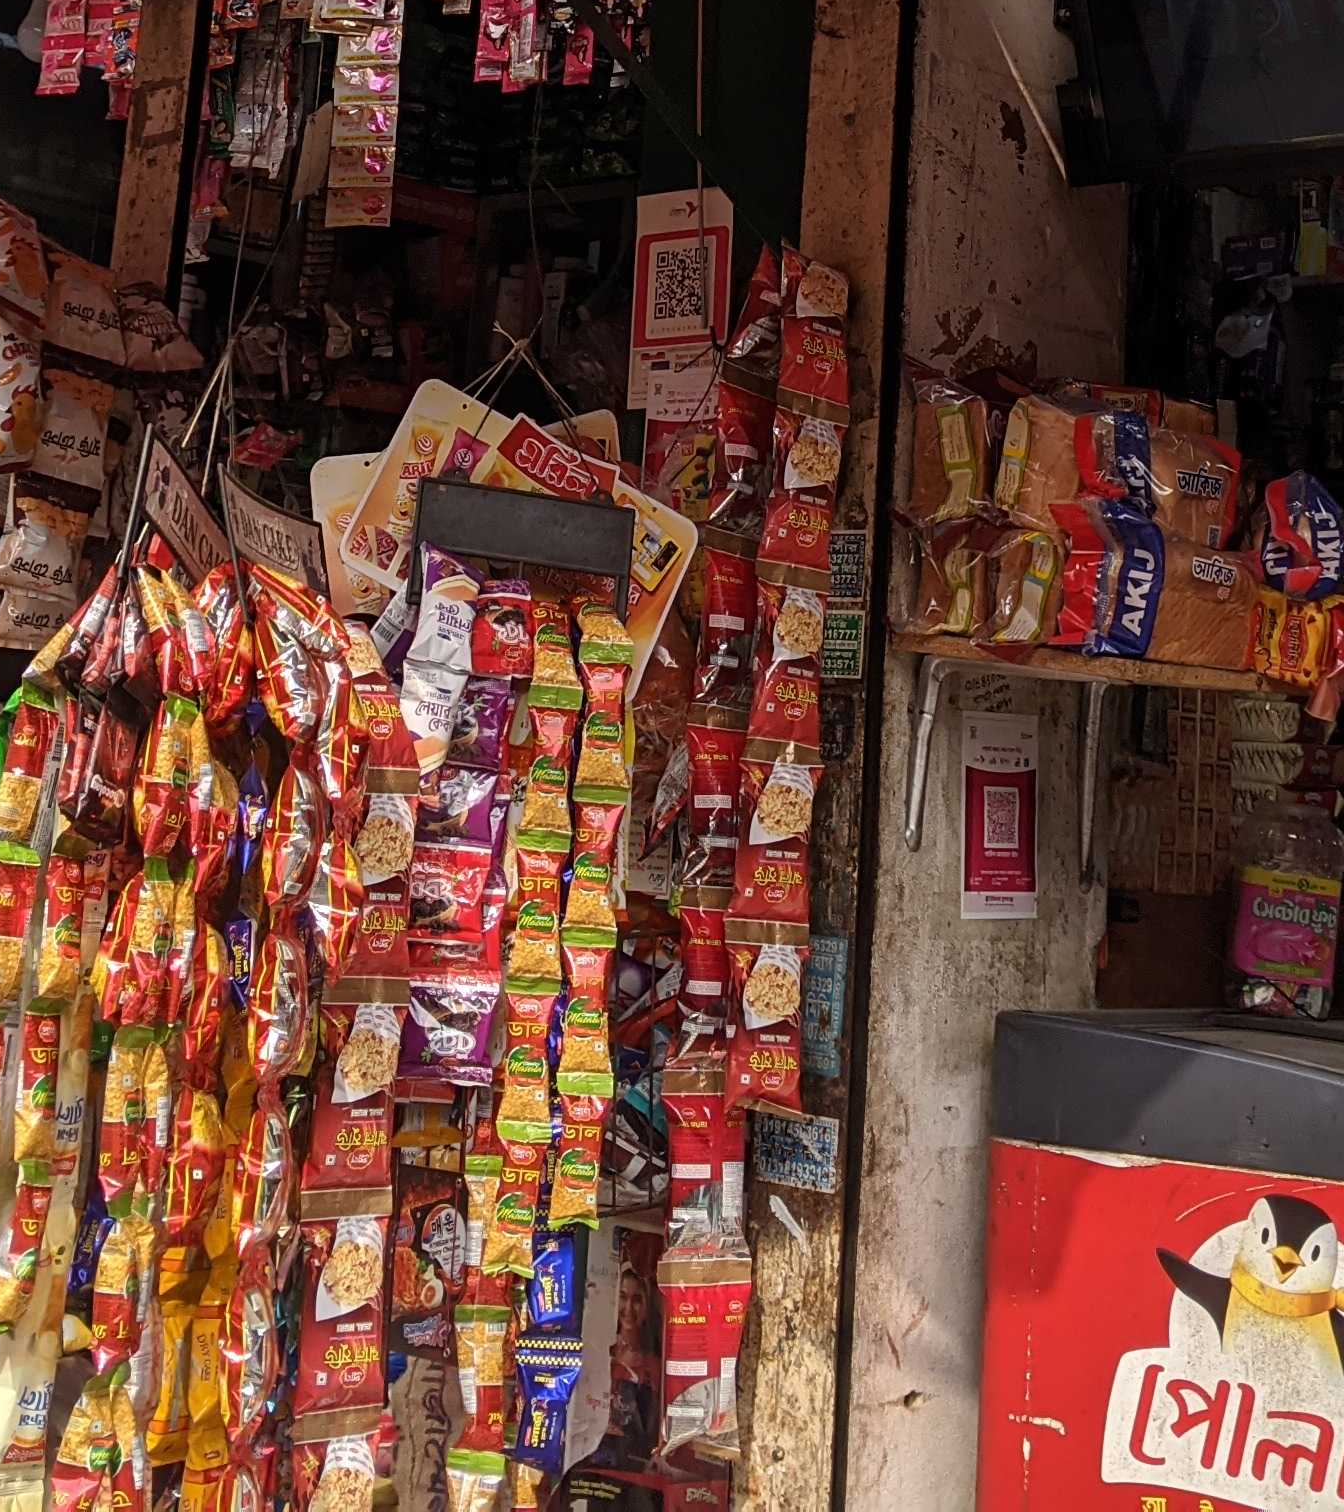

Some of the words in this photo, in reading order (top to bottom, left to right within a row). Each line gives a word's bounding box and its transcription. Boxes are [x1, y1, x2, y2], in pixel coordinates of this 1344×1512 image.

[41, 430, 75, 450] টোস্ট
[77, 437, 100, 457] মুড়ি
[1177, 464, 1224, 498] আকিজ
[11, 557, 48, 579] টোস্ট
[50, 566, 72, 585] মুড়ি
[1192, 553, 1236, 586] আকিজ
[1120, 548, 1155, 637] AKIJ
[575, 865, 610, 881] Masala
[754, 866, 777, 884] মুড়ি
[779, 871, 803, 886] ঝাল
[519, 876, 557, 894] ডাল
[518, 915, 555, 930] Masala
[567, 1015, 602, 1025] Masala
[508, 1022, 547, 1038] ডাল
[509, 1062, 544, 1075] Masala
[749, 1052, 772, 1071] মুড়ি
[773, 1053, 797, 1072] ঝাল
[335, 1126, 361, 1149] মুড়ি
[363, 1129, 387, 1147] ঝাল
[563, 1124, 600, 1141] ডাল
[502, 1167, 540, 1185] ডাল
[561, 1164, 595, 1177] Masala
[497, 1208, 533, 1222] Masala
[324, 1344, 351, 1368] মুড়ি
[353, 1345, 379, 1368] ঝাল
